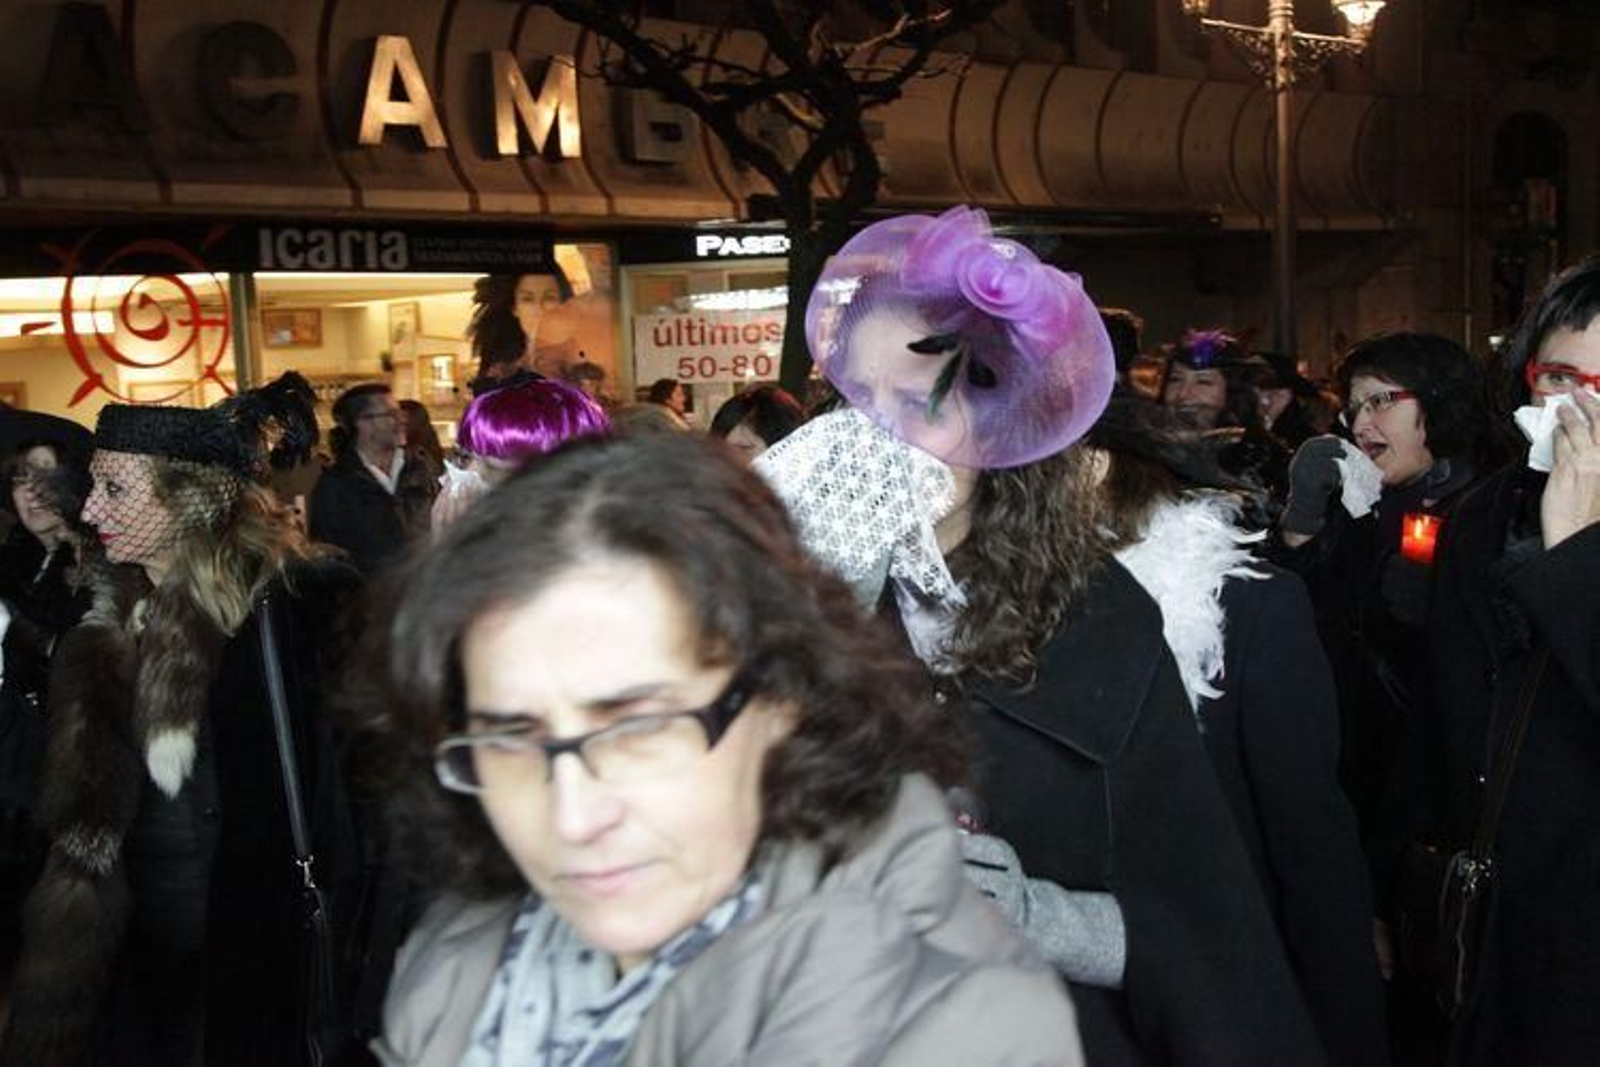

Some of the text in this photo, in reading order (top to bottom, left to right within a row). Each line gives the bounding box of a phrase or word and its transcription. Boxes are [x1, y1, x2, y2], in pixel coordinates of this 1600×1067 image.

[696, 234, 791, 256] PASE
[653, 317, 783, 348] últimos
[677, 353, 773, 379] 50-80
